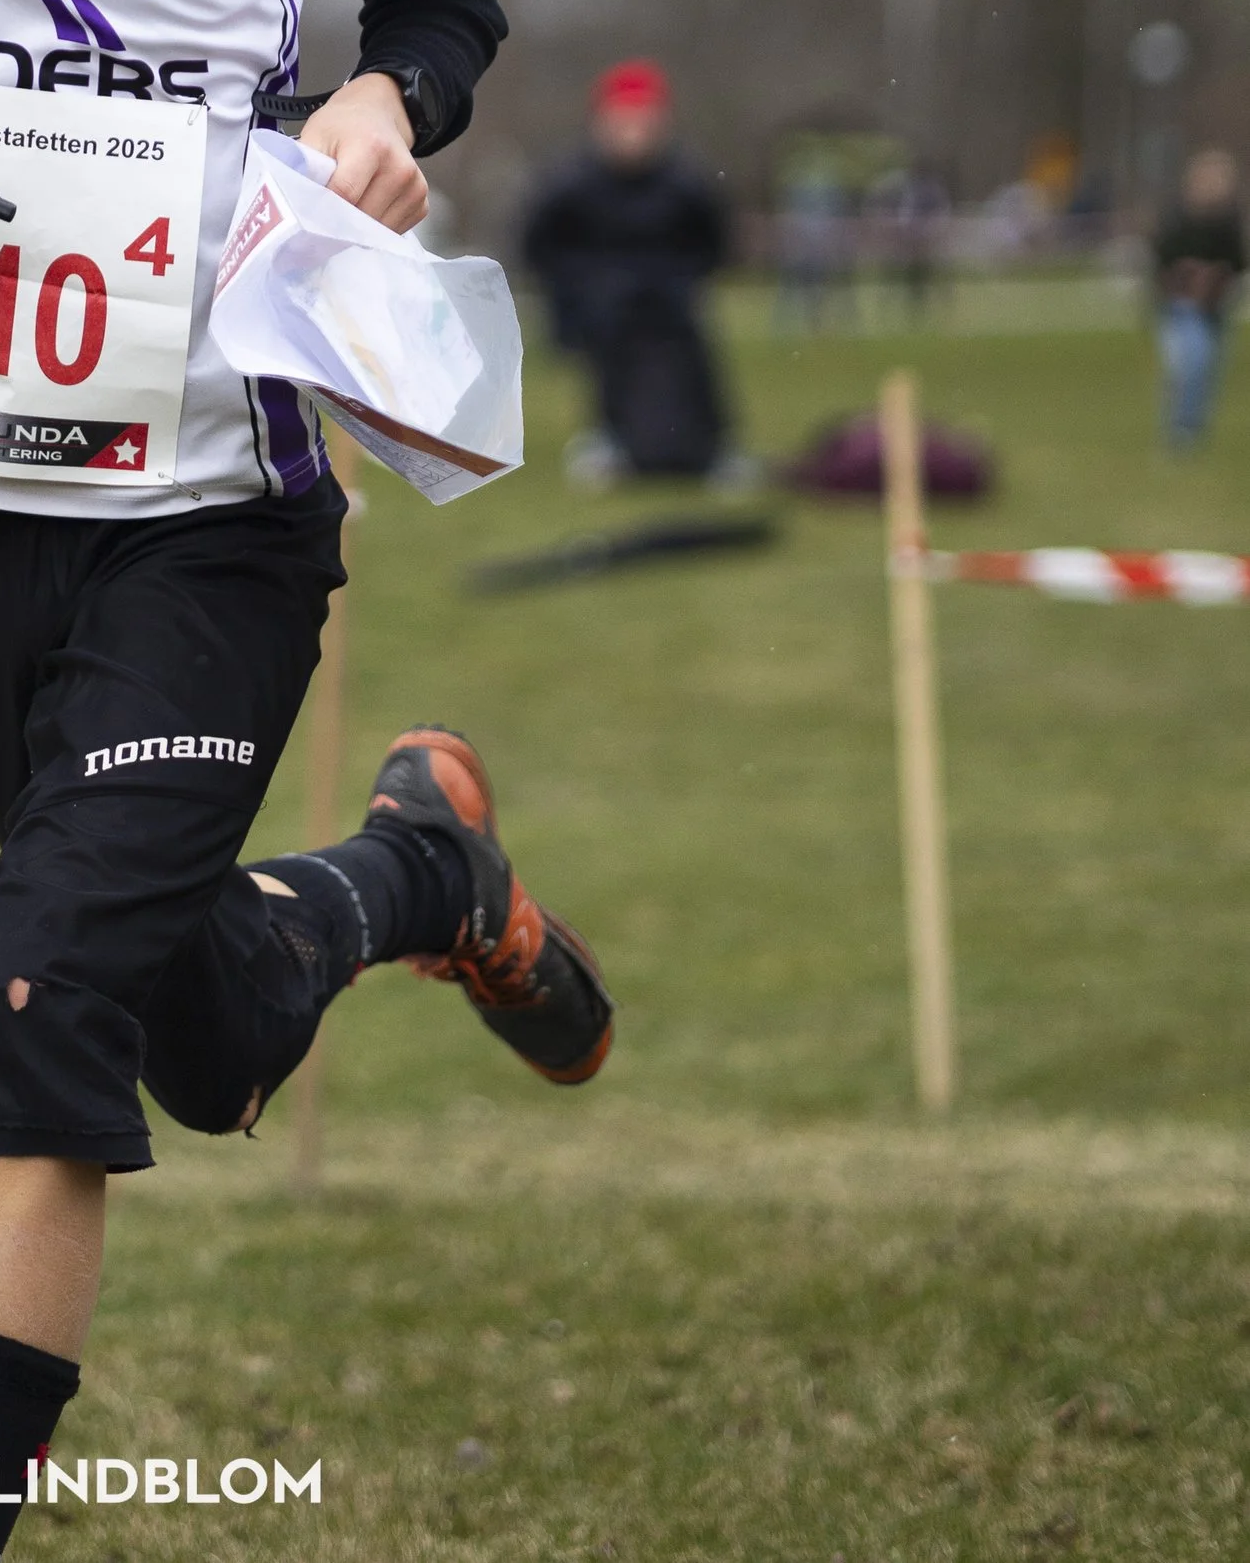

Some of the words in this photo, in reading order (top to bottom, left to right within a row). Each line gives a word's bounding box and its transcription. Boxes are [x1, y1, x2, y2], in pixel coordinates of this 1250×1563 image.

[106, 137, 165, 162] 2025
[123, 216, 175, 277] 4
[216, 201, 271, 286] ATTUND
[84, 735, 256, 777] noname
